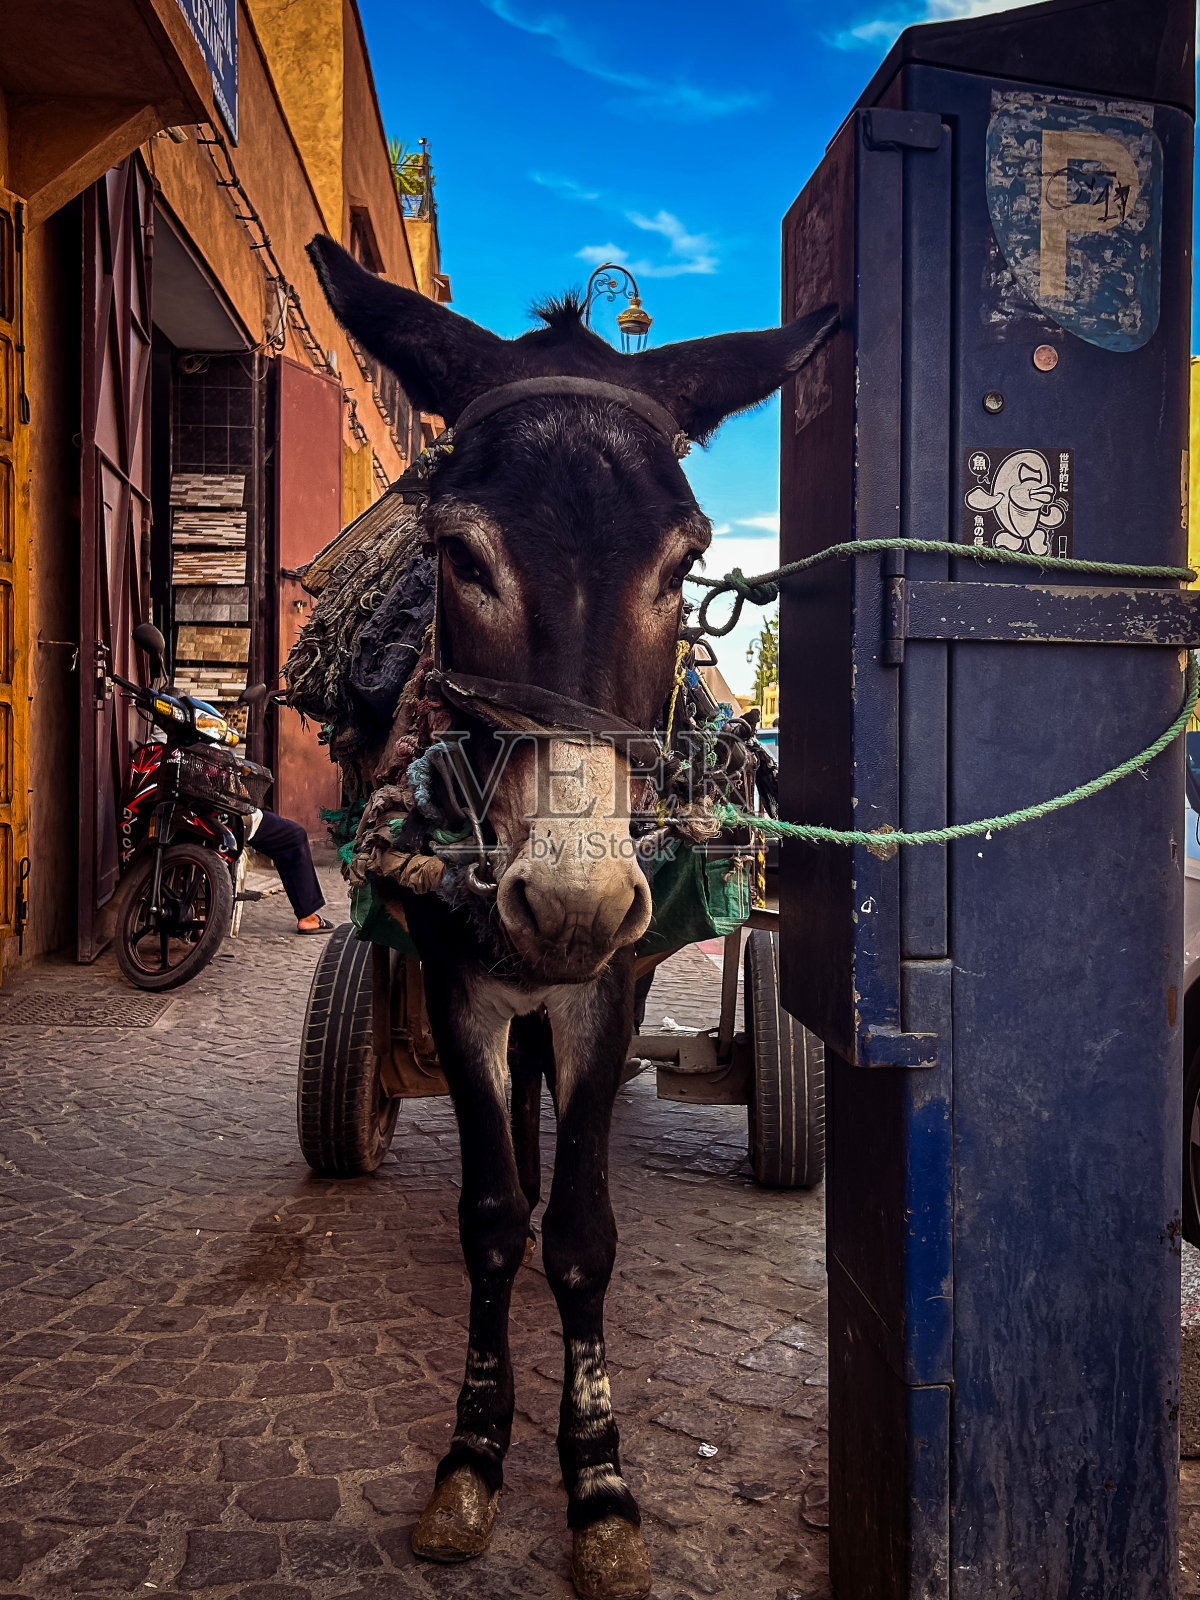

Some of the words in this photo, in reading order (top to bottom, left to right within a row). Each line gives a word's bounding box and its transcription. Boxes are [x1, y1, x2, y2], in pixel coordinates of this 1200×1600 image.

[1041, 129, 1139, 296] P
[972, 455, 986, 471] 魚
[1058, 452, 1070, 493] 世界的に
